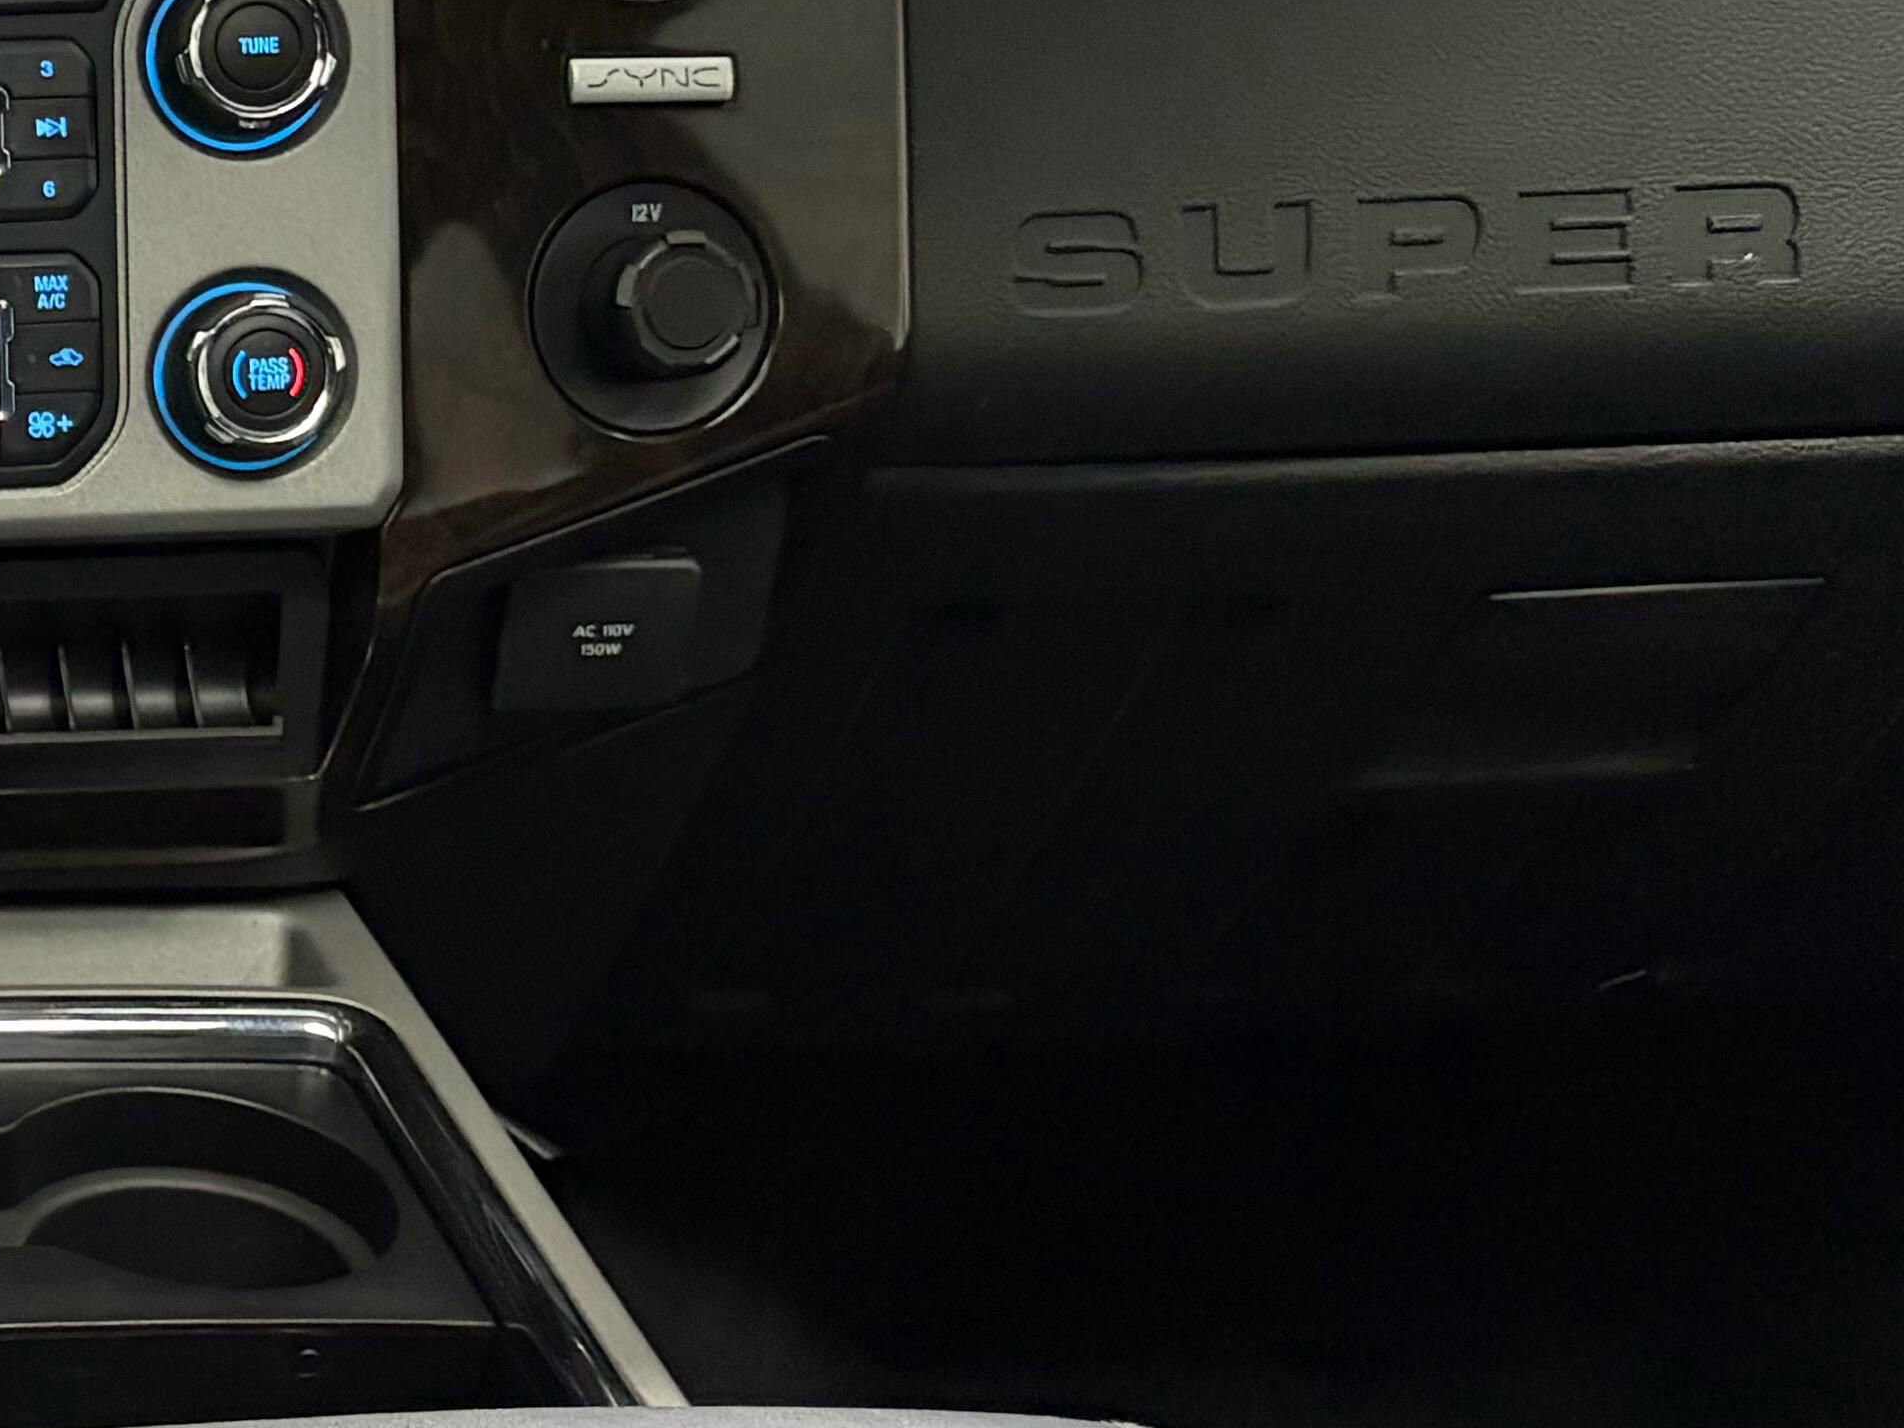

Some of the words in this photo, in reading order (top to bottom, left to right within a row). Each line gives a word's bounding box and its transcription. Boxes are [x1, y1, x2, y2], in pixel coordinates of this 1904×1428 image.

[238, 36, 280, 55] TUNE
[40, 60, 54, 78] 3
[587, 66, 721, 89] SYNC
[42, 180, 56, 199] 6
[631, 202, 663, 224] 12V
[1012, 182, 1802, 320] SUPER
[34, 274, 69, 292] MAX
[37, 292, 67, 310] A/C
[249, 356, 289, 374] PASS
[248, 372, 291, 391] TEMP
[572, 624, 596, 638] AC
[602, 623, 635, 638] 110V
[580, 642, 622, 657] 150W
